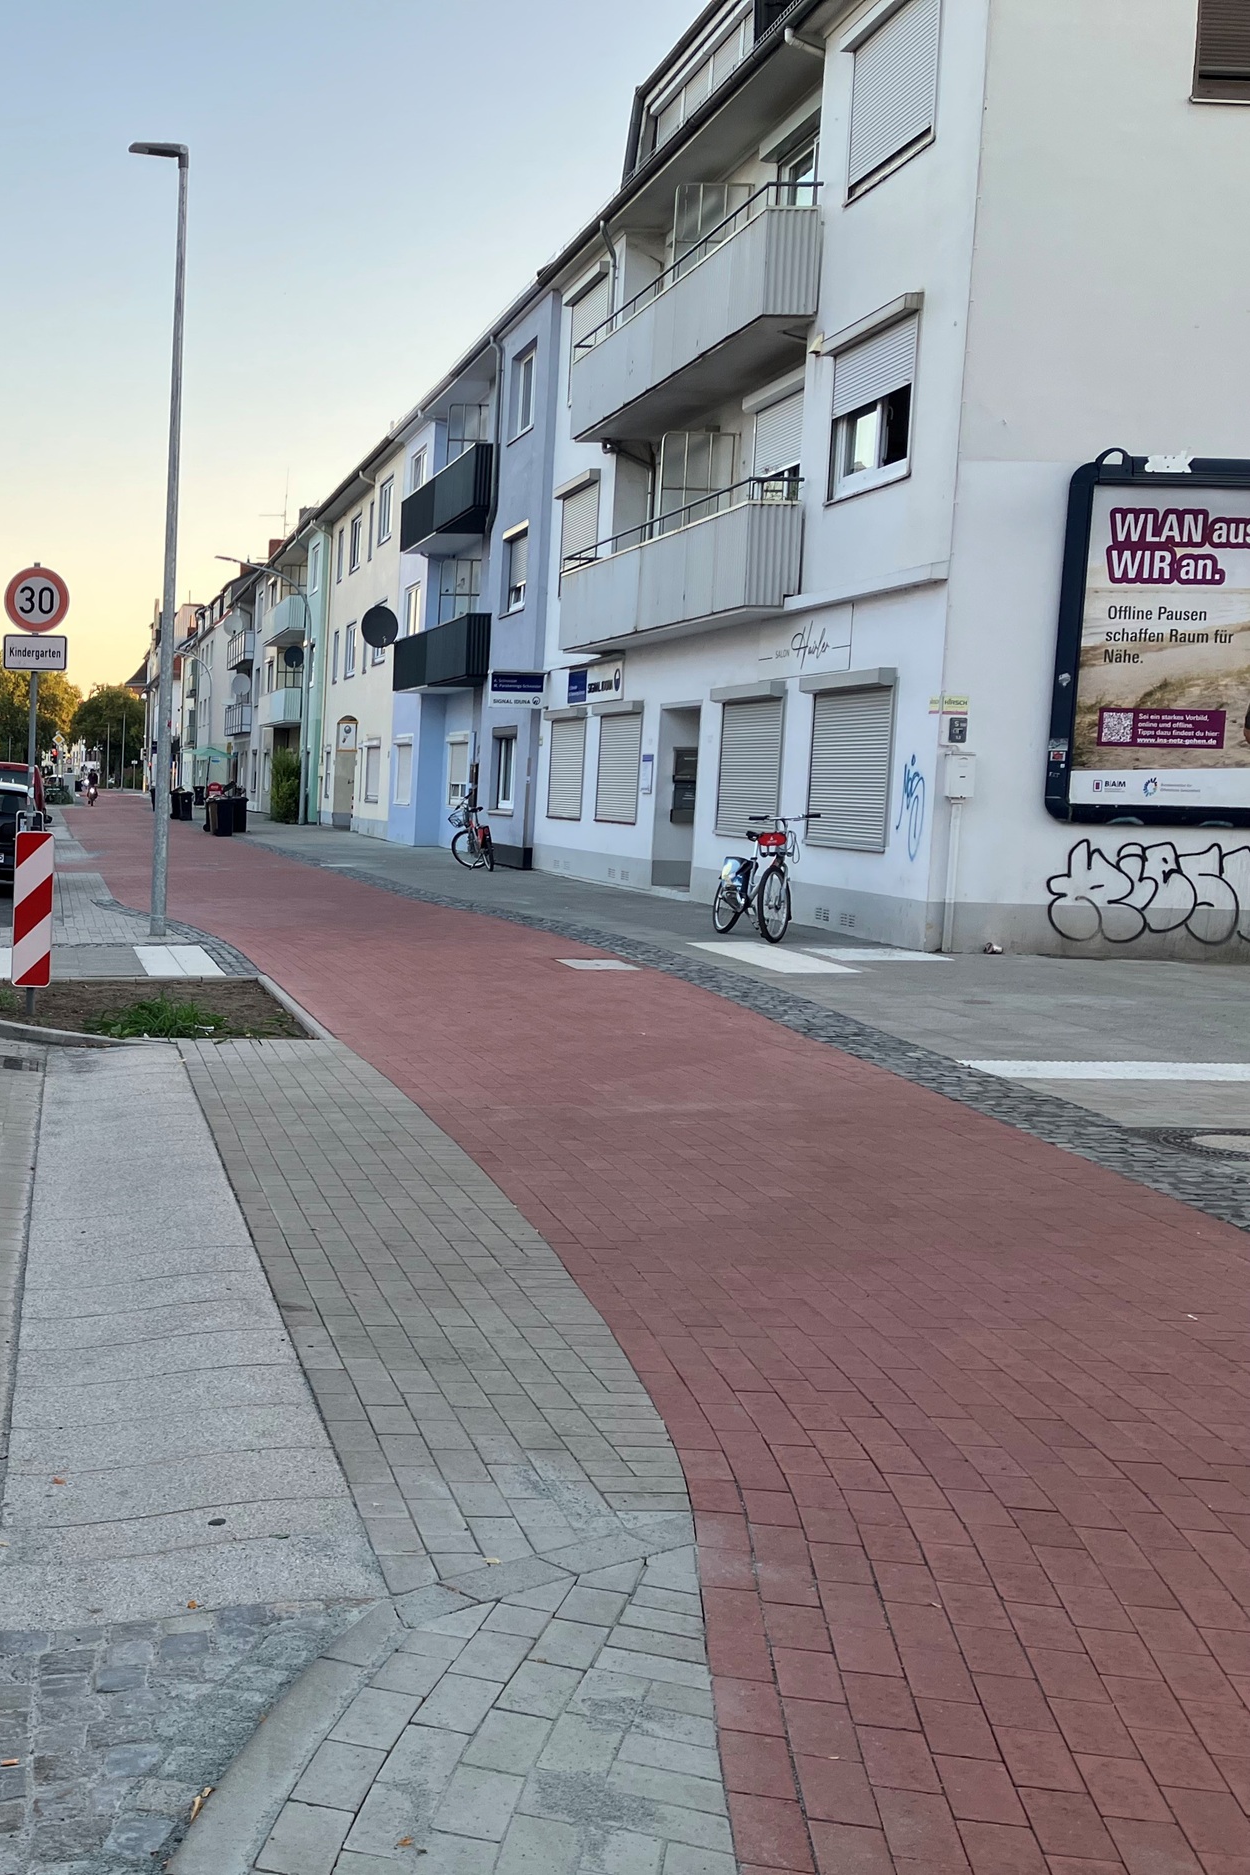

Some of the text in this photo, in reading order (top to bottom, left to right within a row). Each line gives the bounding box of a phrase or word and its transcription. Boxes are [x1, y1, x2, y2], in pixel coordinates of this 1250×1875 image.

[1115, 513, 1204, 542] WLAN
[1111, 550, 1220, 580] WIR an.
[19, 585, 54, 615] 30
[1107, 605, 1207, 621] Offline Pausen
[1105, 628, 1234, 644] schaffen Raum für
[9, 646, 61, 660] Kindergarten
[1103, 648, 1144, 664] Nähe.
[1161, 713, 1184, 721] starkes
[1185, 714, 1210, 722] Vorbild,
[1172, 721, 1194, 729] offline.
[1137, 728, 1155, 736] Tipps
